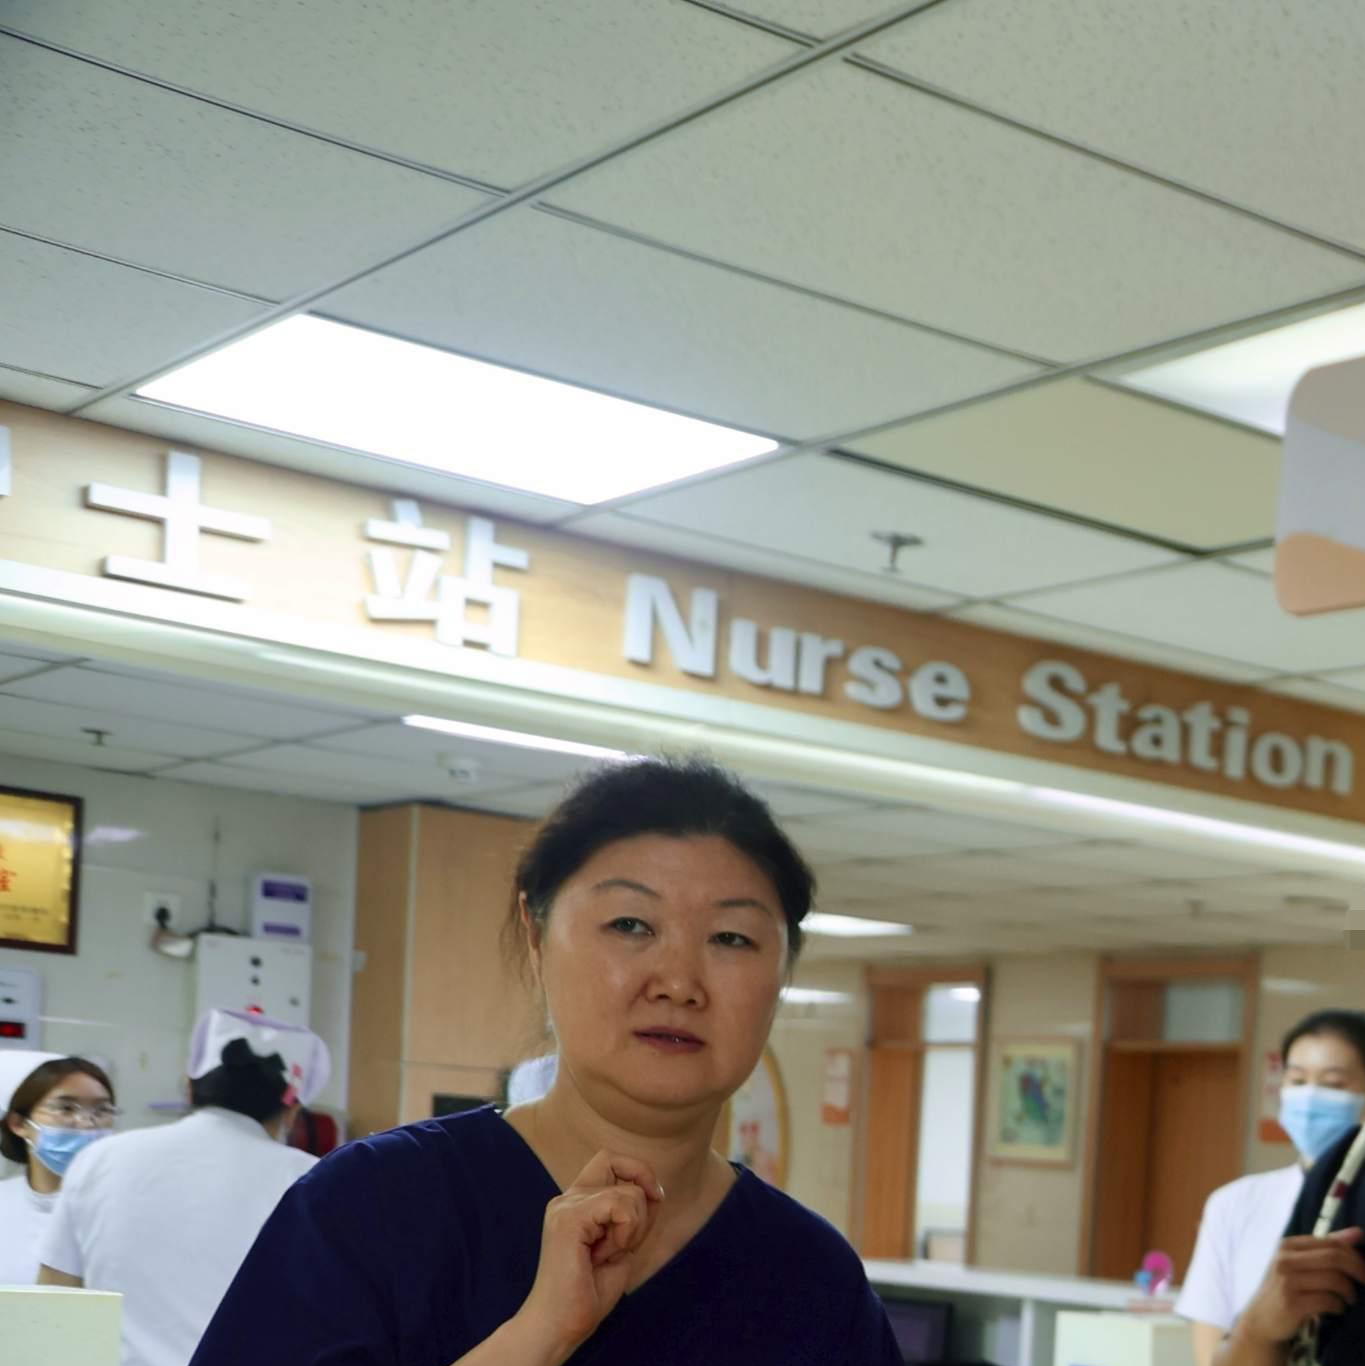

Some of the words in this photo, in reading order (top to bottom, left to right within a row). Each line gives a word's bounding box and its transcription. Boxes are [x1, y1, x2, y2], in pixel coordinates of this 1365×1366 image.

[0, 425, 530, 660] 士站
[622, 571, 972, 723] Nurse
[1017, 659, 1355, 796] Station
